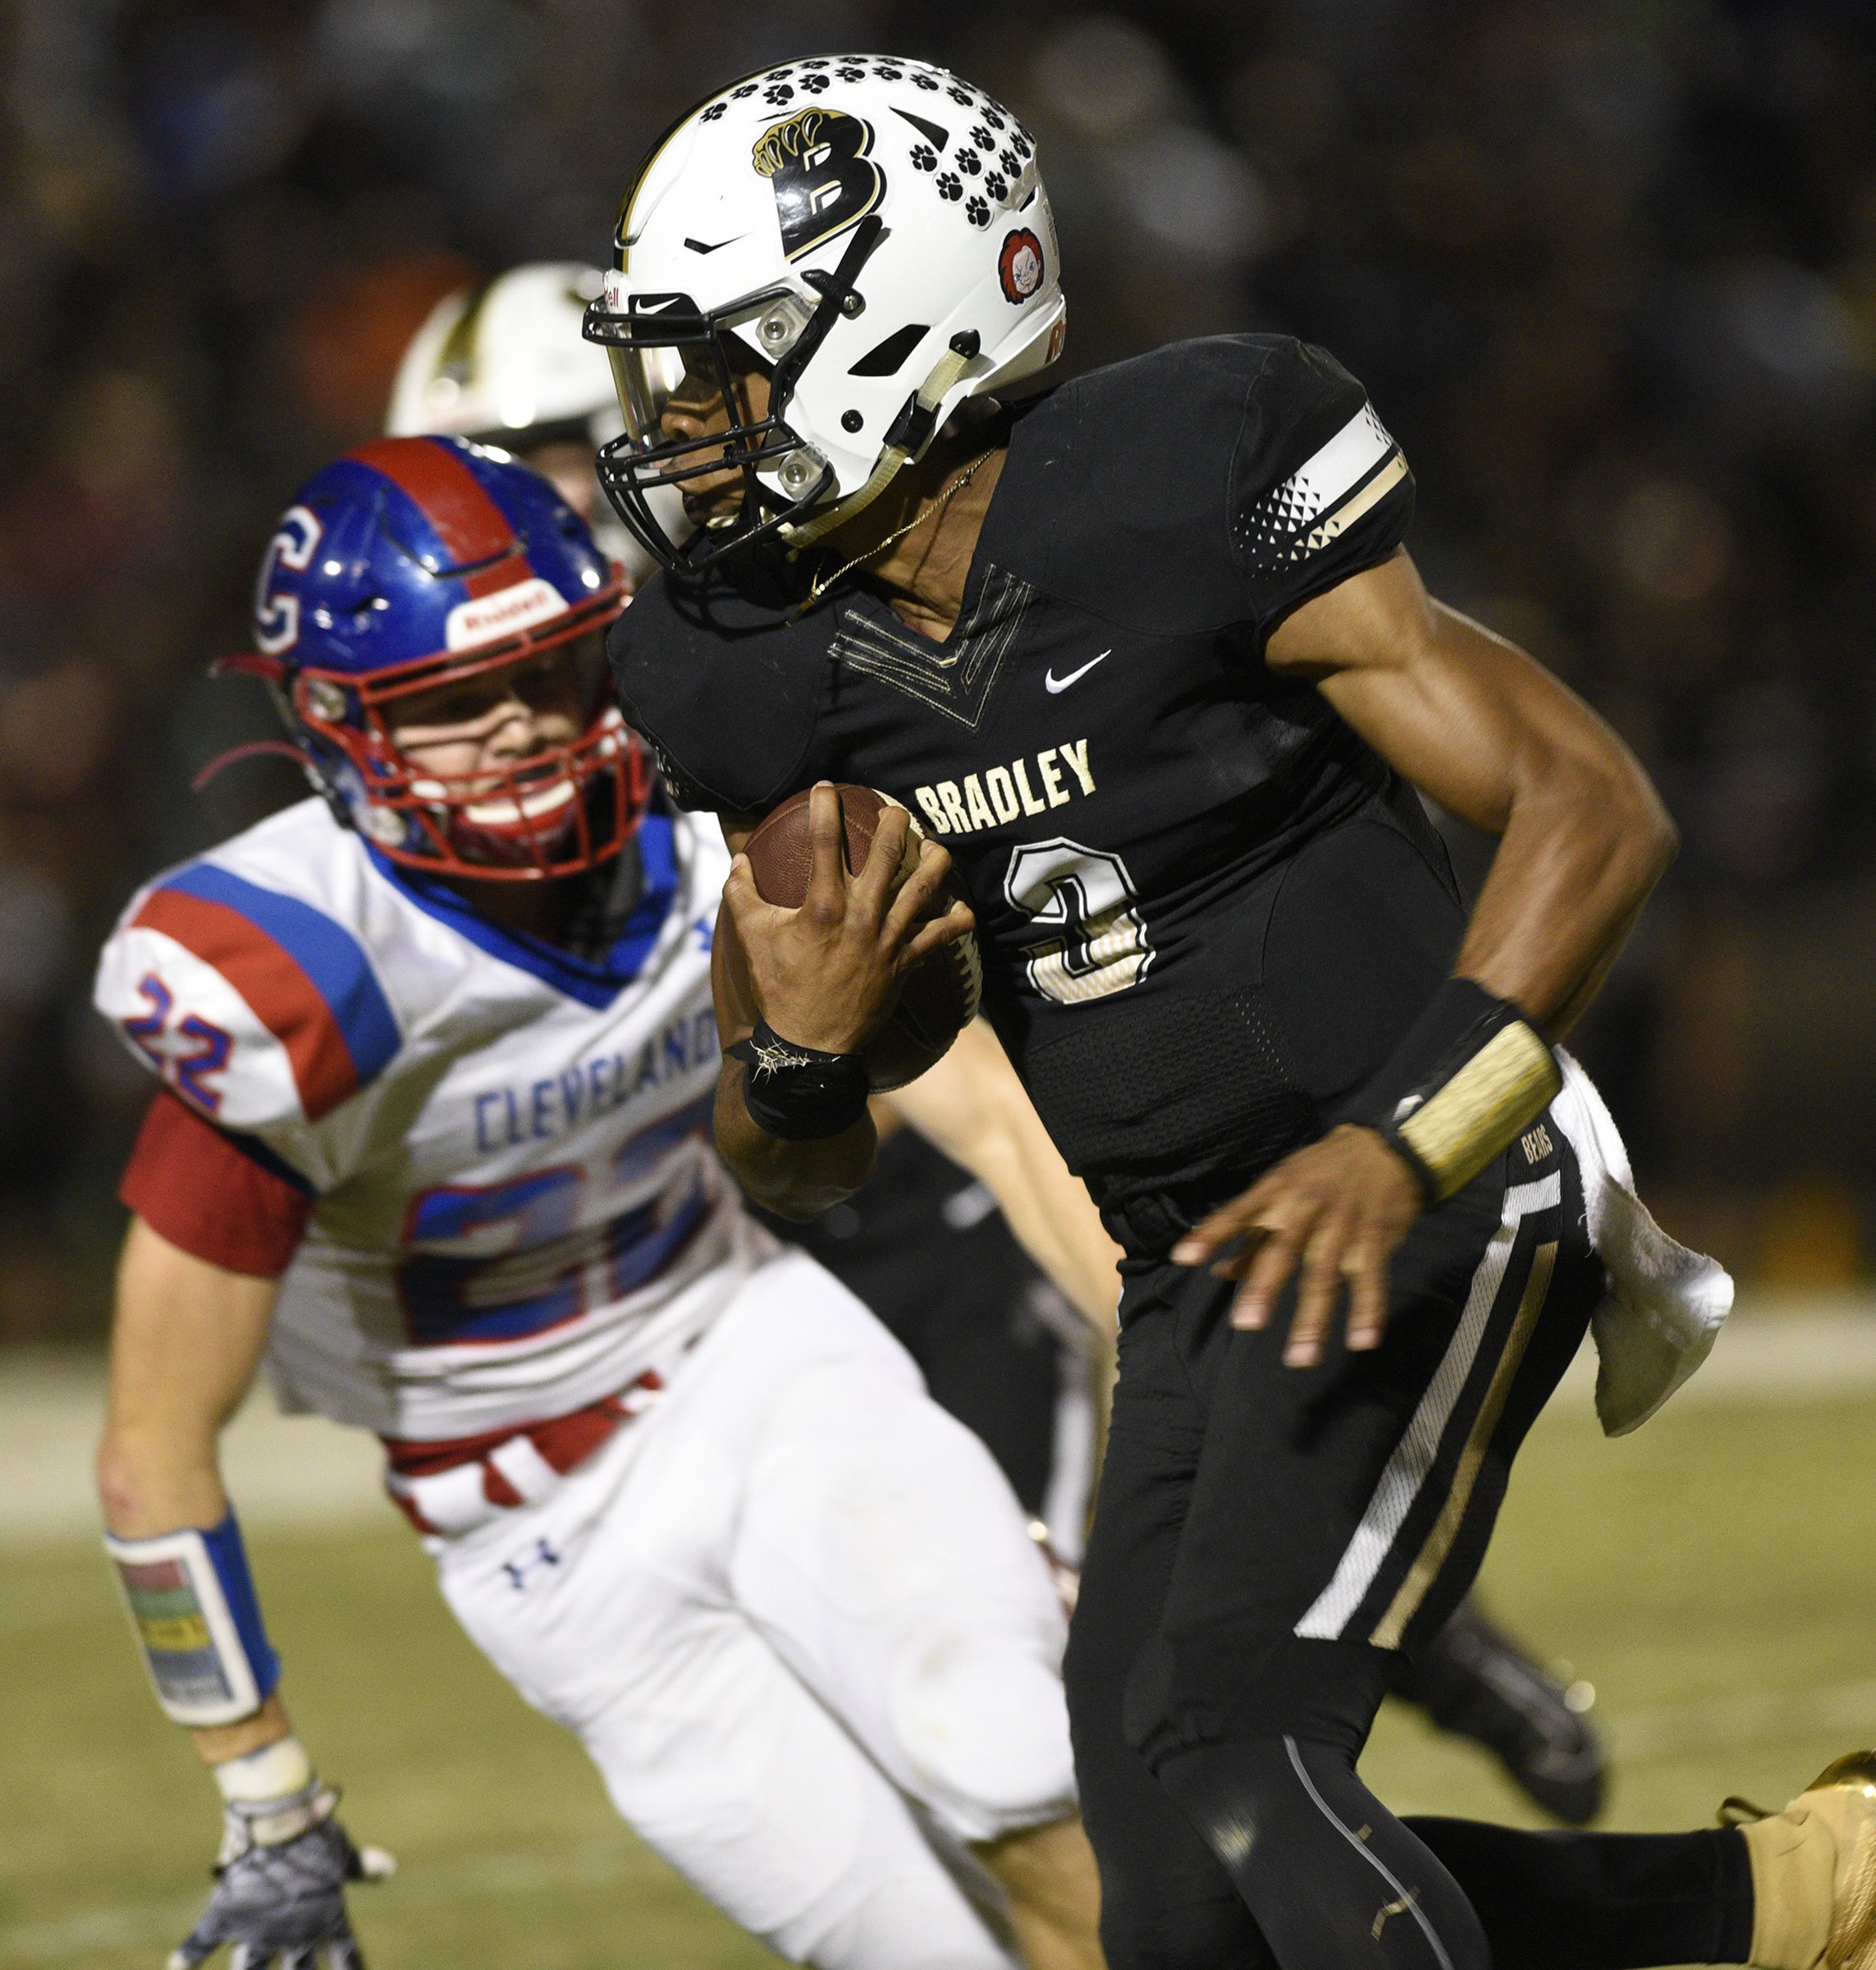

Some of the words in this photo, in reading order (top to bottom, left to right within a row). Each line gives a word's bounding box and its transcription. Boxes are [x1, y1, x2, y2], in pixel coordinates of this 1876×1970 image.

[254, 505, 323, 655] C
[915, 738, 1096, 834] BRADLEY
[1003, 836, 1156, 1005] 3
[121, 969, 233, 1115] 22
[475, 1008, 716, 1153] CLEVELAND
[1521, 1124, 1553, 1165] BEARS
[396, 1088, 720, 1348] 22
